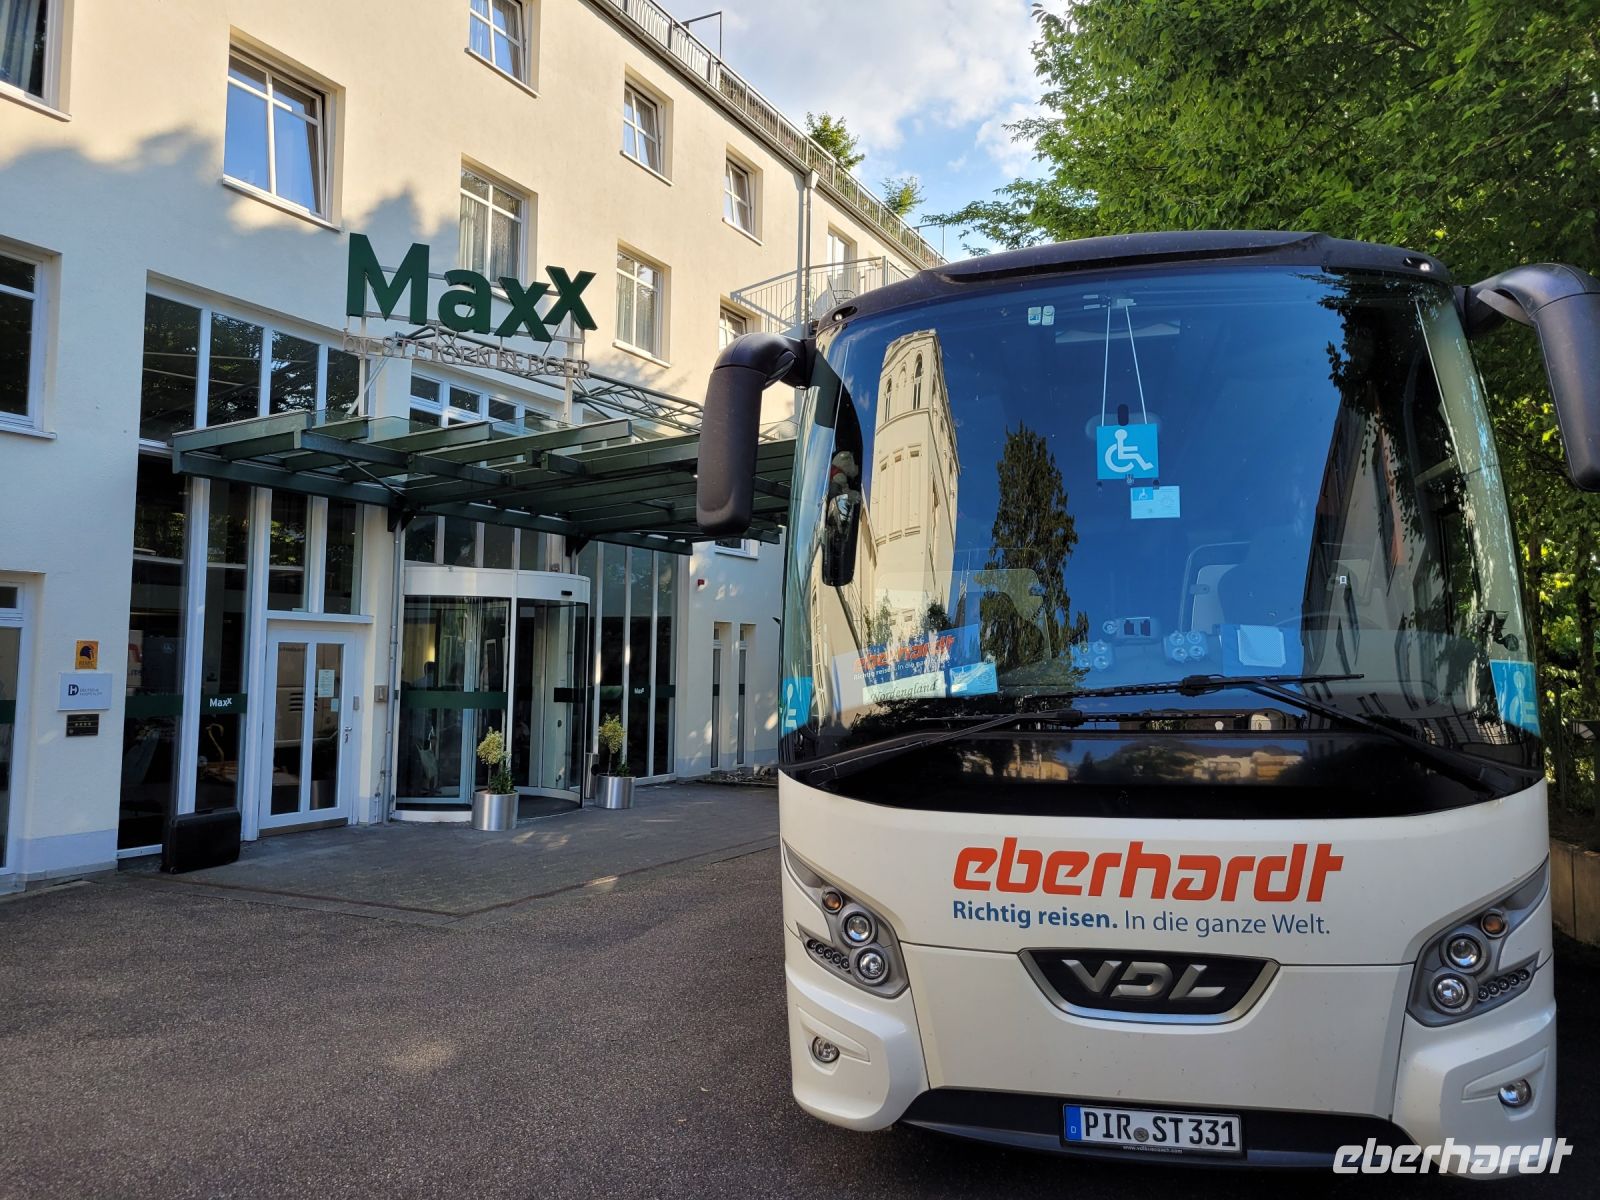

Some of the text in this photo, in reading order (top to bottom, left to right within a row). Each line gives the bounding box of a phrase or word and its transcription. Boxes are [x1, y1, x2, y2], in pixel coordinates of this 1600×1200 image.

[346, 232, 599, 342] Maxx
[382, 335, 592, 380] STEIGENBERGER
[209, 697, 233, 707] Maxx
[870, 679, 938, 701] Nordengland
[953, 837, 1345, 902] eberhardt
[953, 901, 1331, 938] Richtig reisen. In die ganze Welt.
[1061, 959, 1226, 1000] VDL
[1083, 1111, 1132, 1140] PIR
